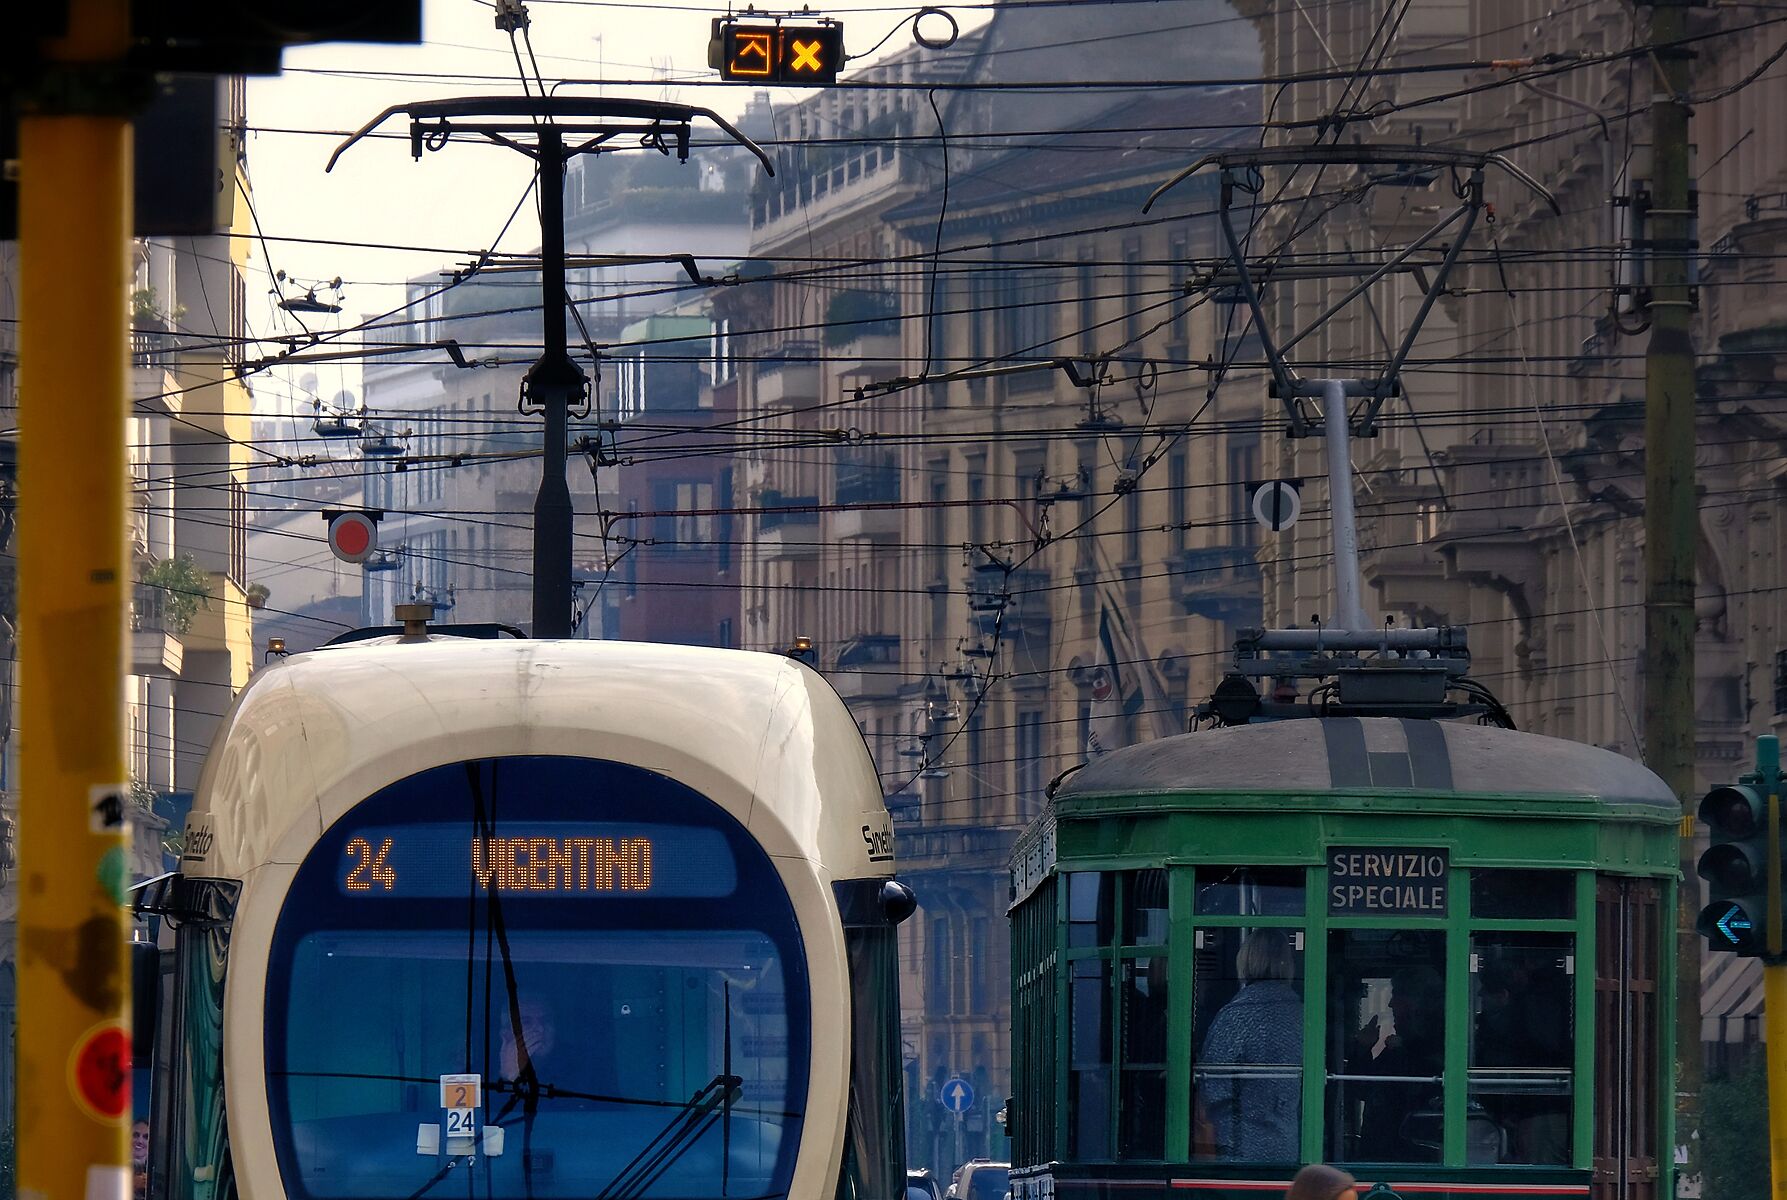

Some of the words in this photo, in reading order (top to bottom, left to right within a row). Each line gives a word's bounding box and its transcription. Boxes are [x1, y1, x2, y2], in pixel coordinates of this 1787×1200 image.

[346, 838, 395, 890] 24
[472, 838, 651, 890] VIGENTINO
[1333, 854, 1444, 877] SERVIZIO
[1332, 885, 1444, 909] SPECIALE
[455, 1086, 466, 1107] 2
[448, 1111, 474, 1132] 24
